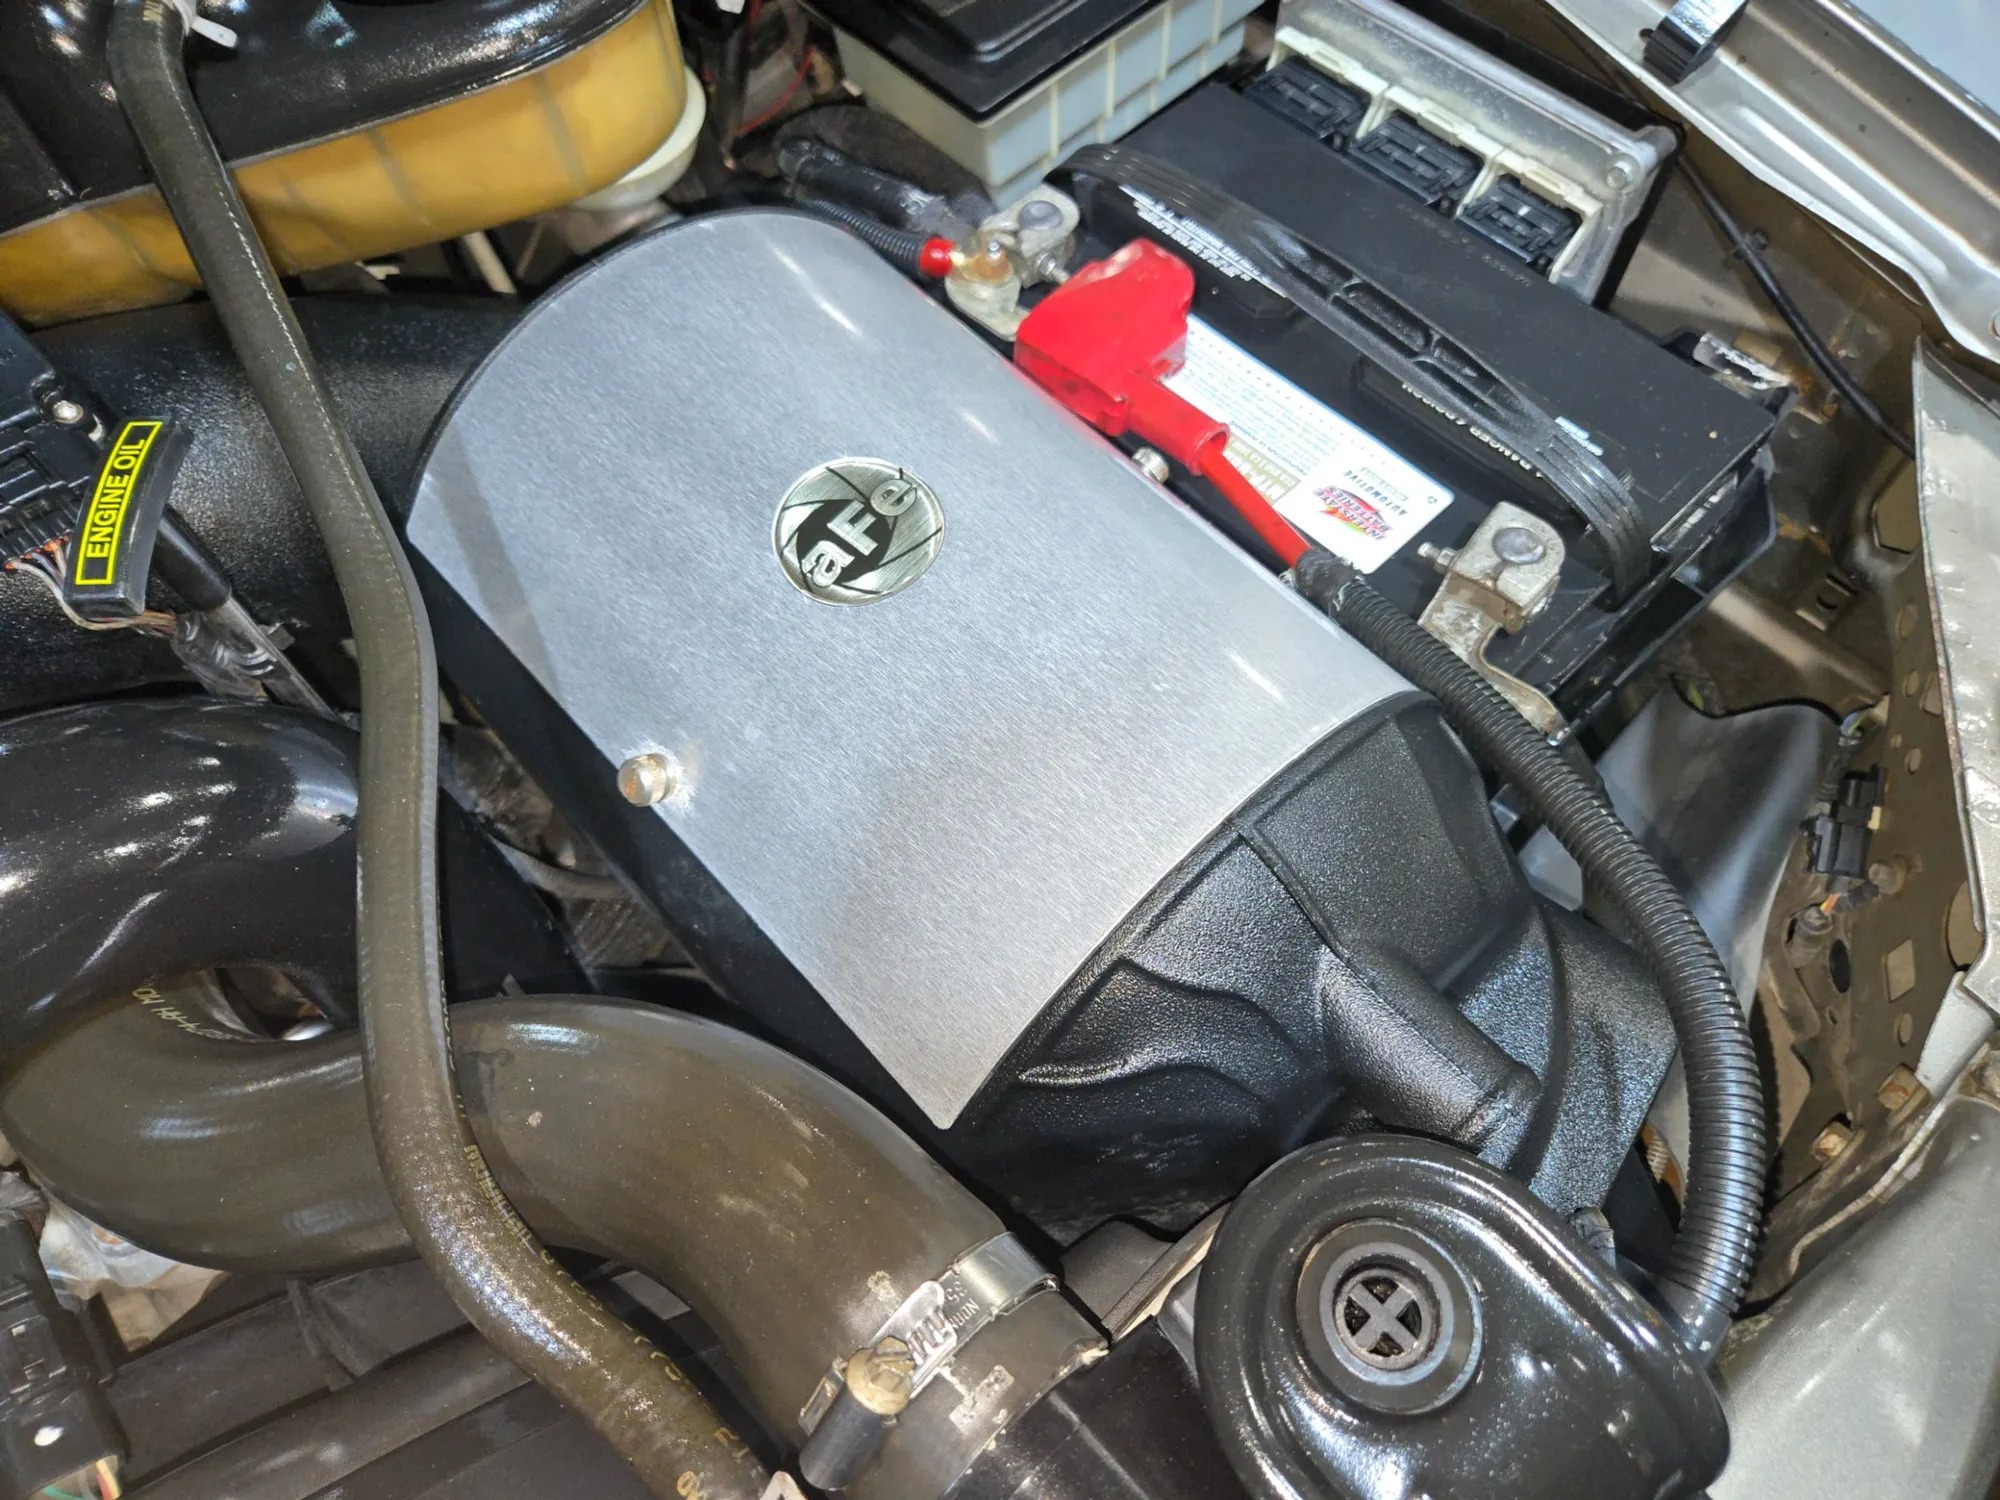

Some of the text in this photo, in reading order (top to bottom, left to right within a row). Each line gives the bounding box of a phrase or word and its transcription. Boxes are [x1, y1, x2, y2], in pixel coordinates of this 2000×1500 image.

[86, 439, 146, 558] ENGINE OIL
[1312, 487, 1386, 541] INTERSTATE
[1326, 485, 1391, 533] BATTERIES
[1343, 470, 1408, 516] AUTOMOTIVE
[801, 478, 918, 588] aFe
